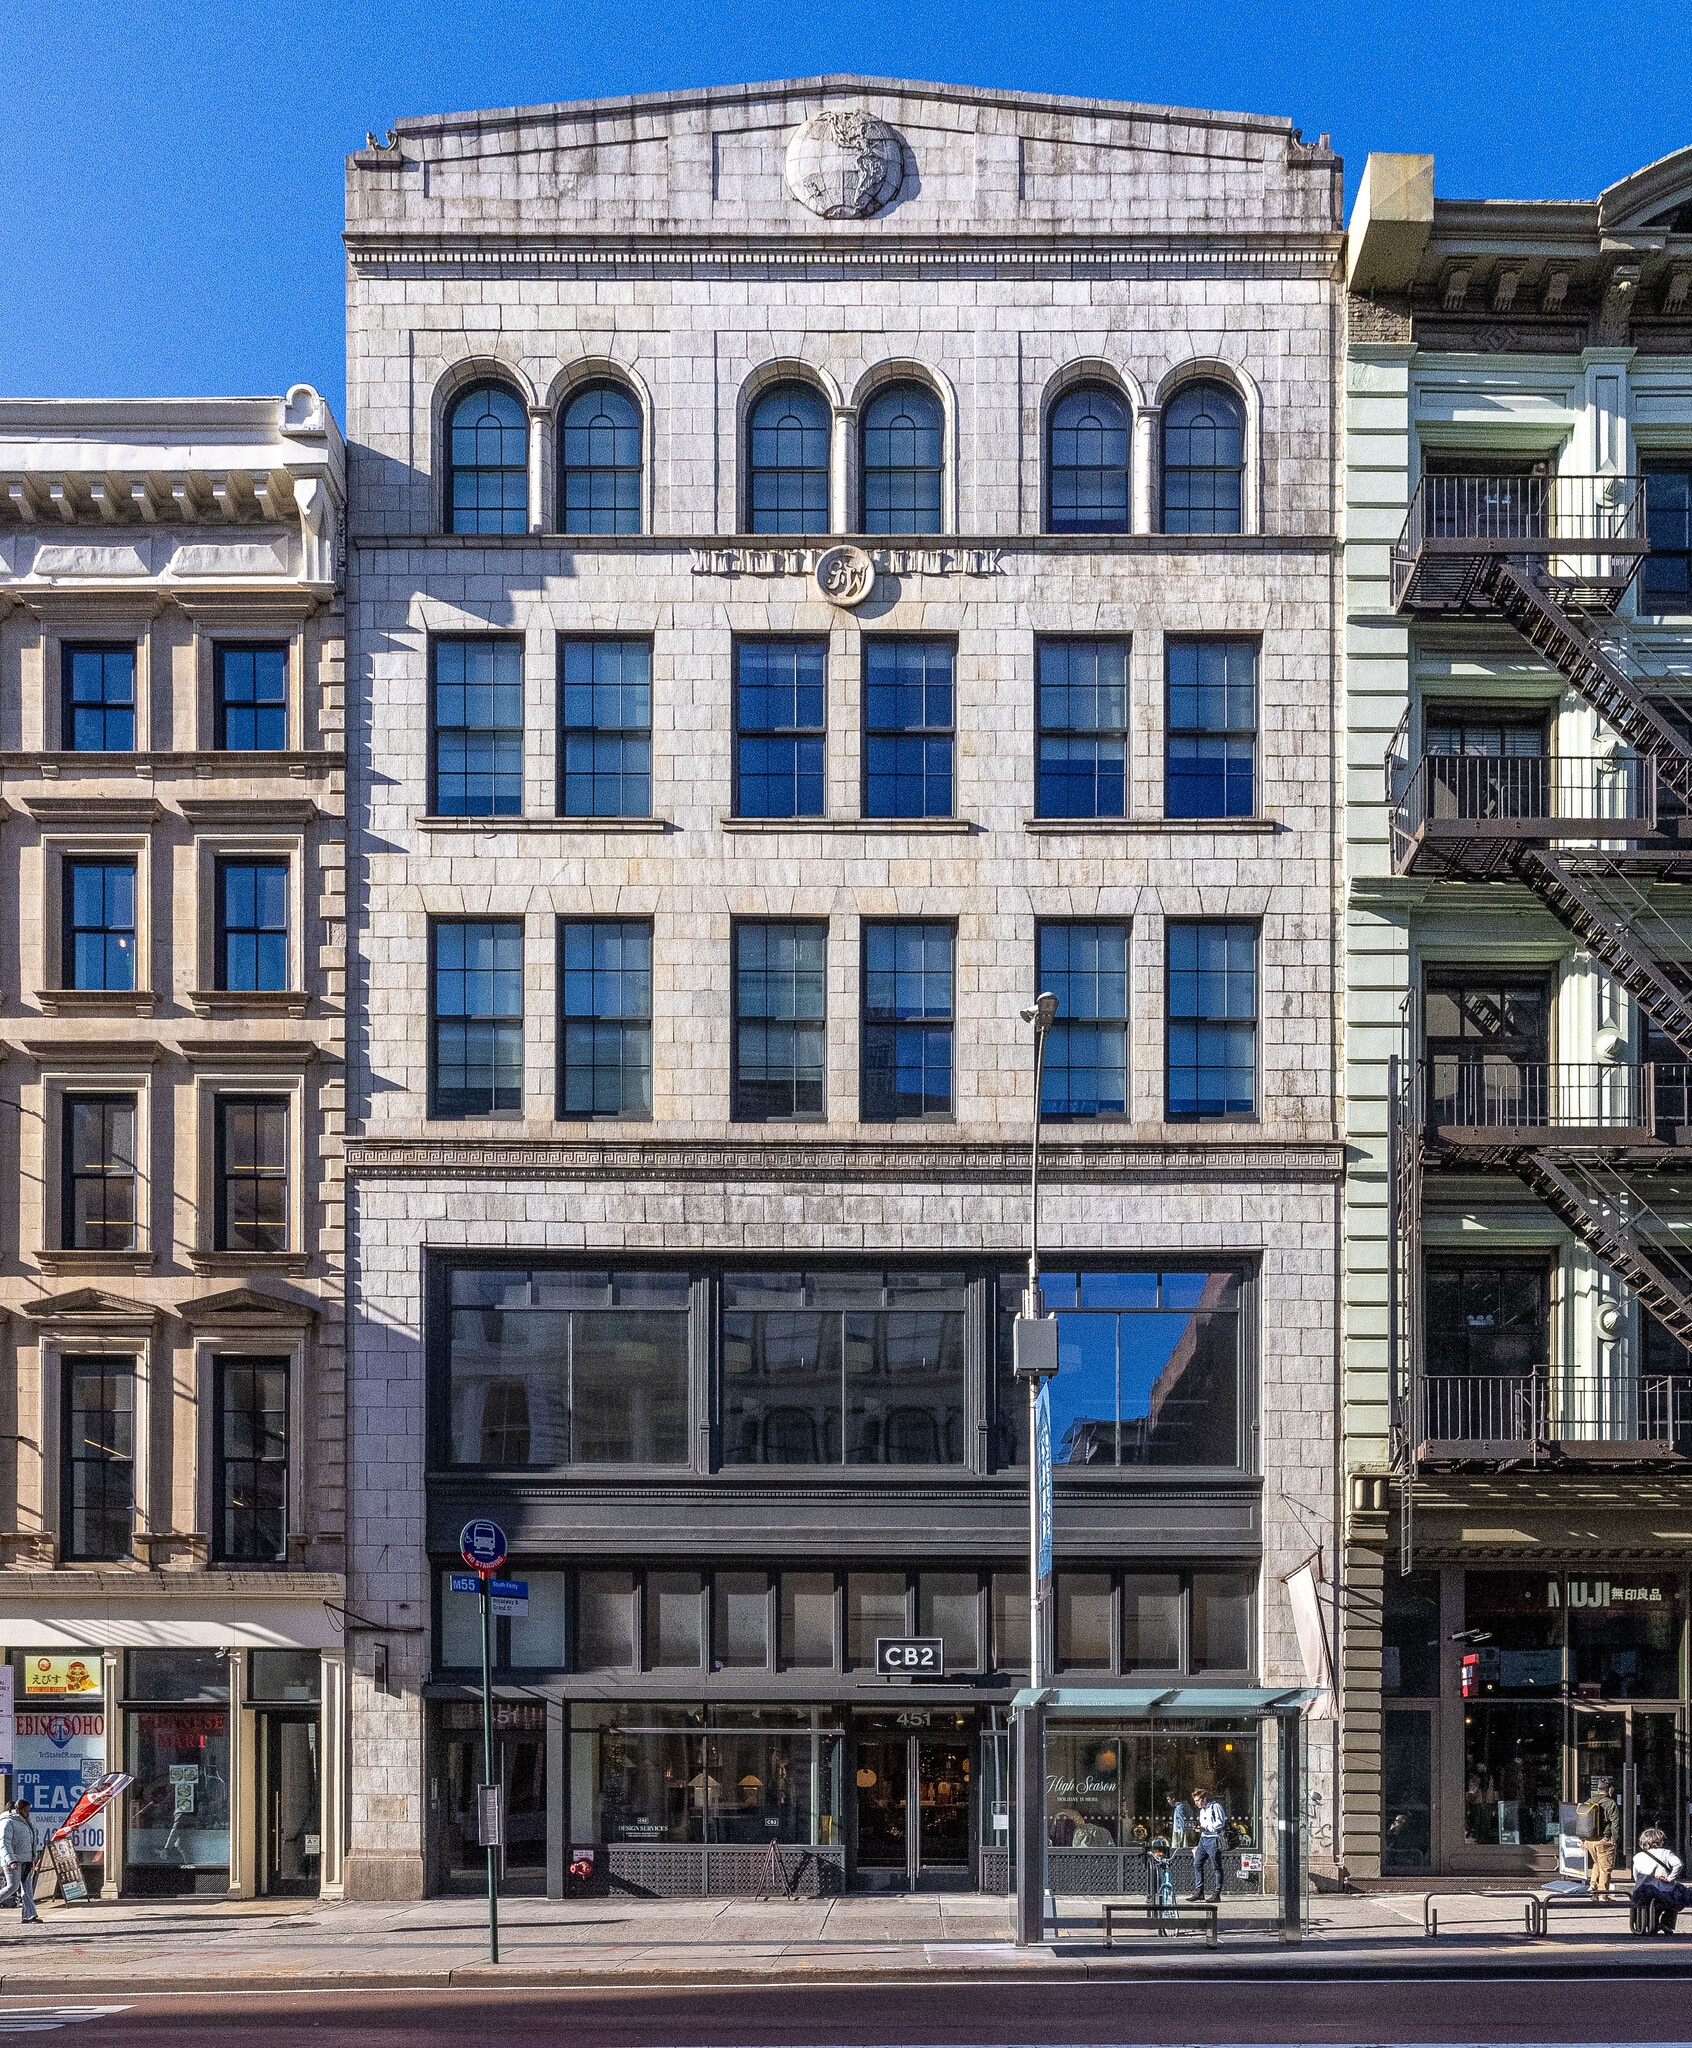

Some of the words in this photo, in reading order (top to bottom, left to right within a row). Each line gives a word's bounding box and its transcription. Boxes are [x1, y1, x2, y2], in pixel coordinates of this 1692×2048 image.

[466, 1553, 475, 1563] NO
[475, 1556, 504, 1569] STANDING
[453, 1578, 476, 1591] M55
[1547, 1581, 1610, 1608] MUJI
[1611, 1587, 1662, 1601] 無印良品
[492, 1598, 514, 1606] Broadway
[885, 1647, 934, 1666] CB2
[32, 1674, 61, 1685] えびす
[16, 1715, 58, 1736] EBISU
[63, 1715, 104, 1736] SOHO
[896, 1711, 932, 1726] 451
[17, 1773, 40, 1784] FOR
[1045, 1775, 1076, 1796] High
[1076, 1775, 1117, 1794] Season
[17, 1785, 88, 1809] LEAS
